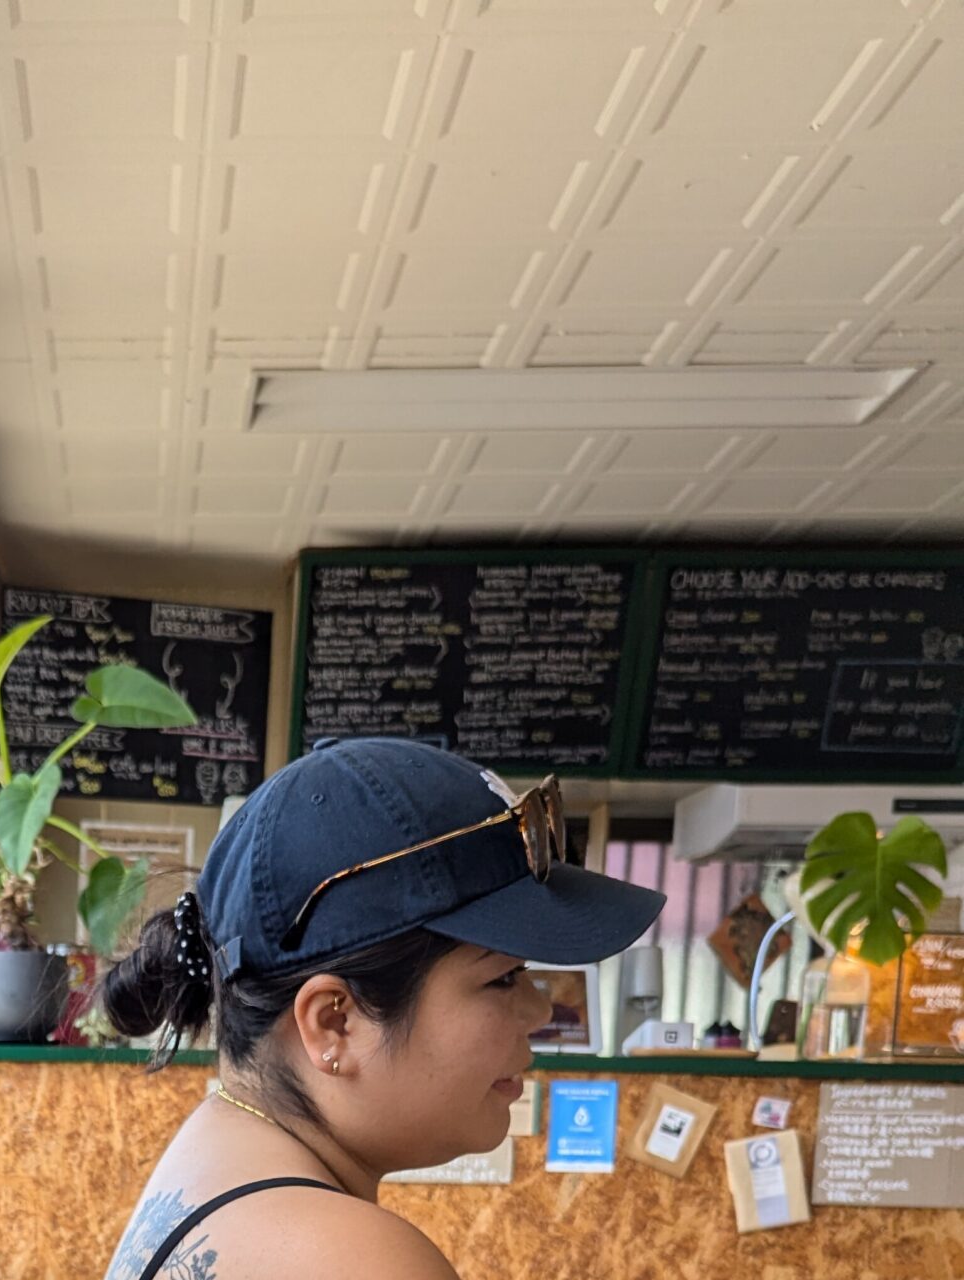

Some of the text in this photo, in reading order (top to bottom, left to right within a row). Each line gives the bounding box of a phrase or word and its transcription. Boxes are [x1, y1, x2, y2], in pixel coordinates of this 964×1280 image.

[670, 569, 737, 590] CHOOSE
[739, 569, 779, 589] YOUR
[779, 569, 846, 590] ADD-ONS
[849, 571, 871, 589] OR
[157, 621, 197, 635] FRESH
